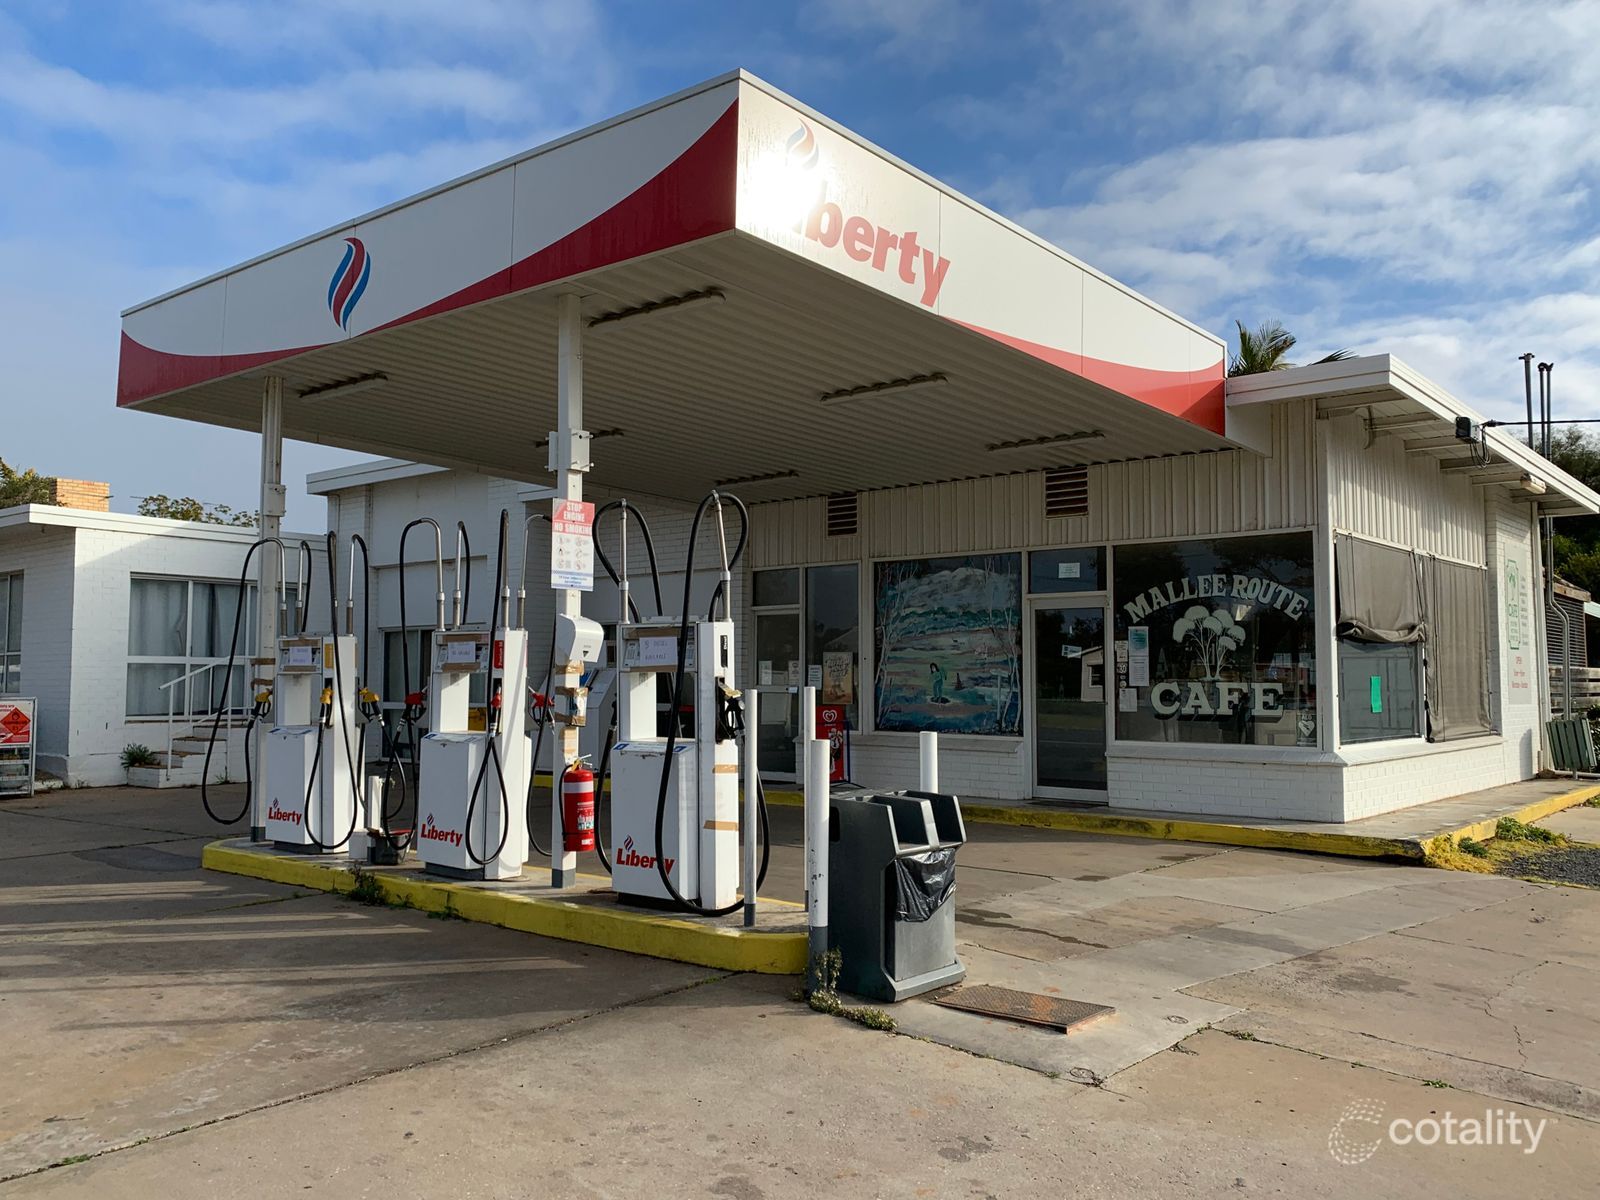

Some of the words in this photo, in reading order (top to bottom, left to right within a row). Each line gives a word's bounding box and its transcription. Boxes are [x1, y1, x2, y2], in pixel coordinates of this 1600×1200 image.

[566, 501, 583, 513] STOP
[1124, 574, 1227, 624] MALLEE
[1231, 574, 1309, 622] ROUTE
[1151, 681, 1284, 718] CAFE
[268, 807, 302, 826] Liberty
[421, 824, 463, 847] Liberty
[616, 848, 675, 876] Libery
